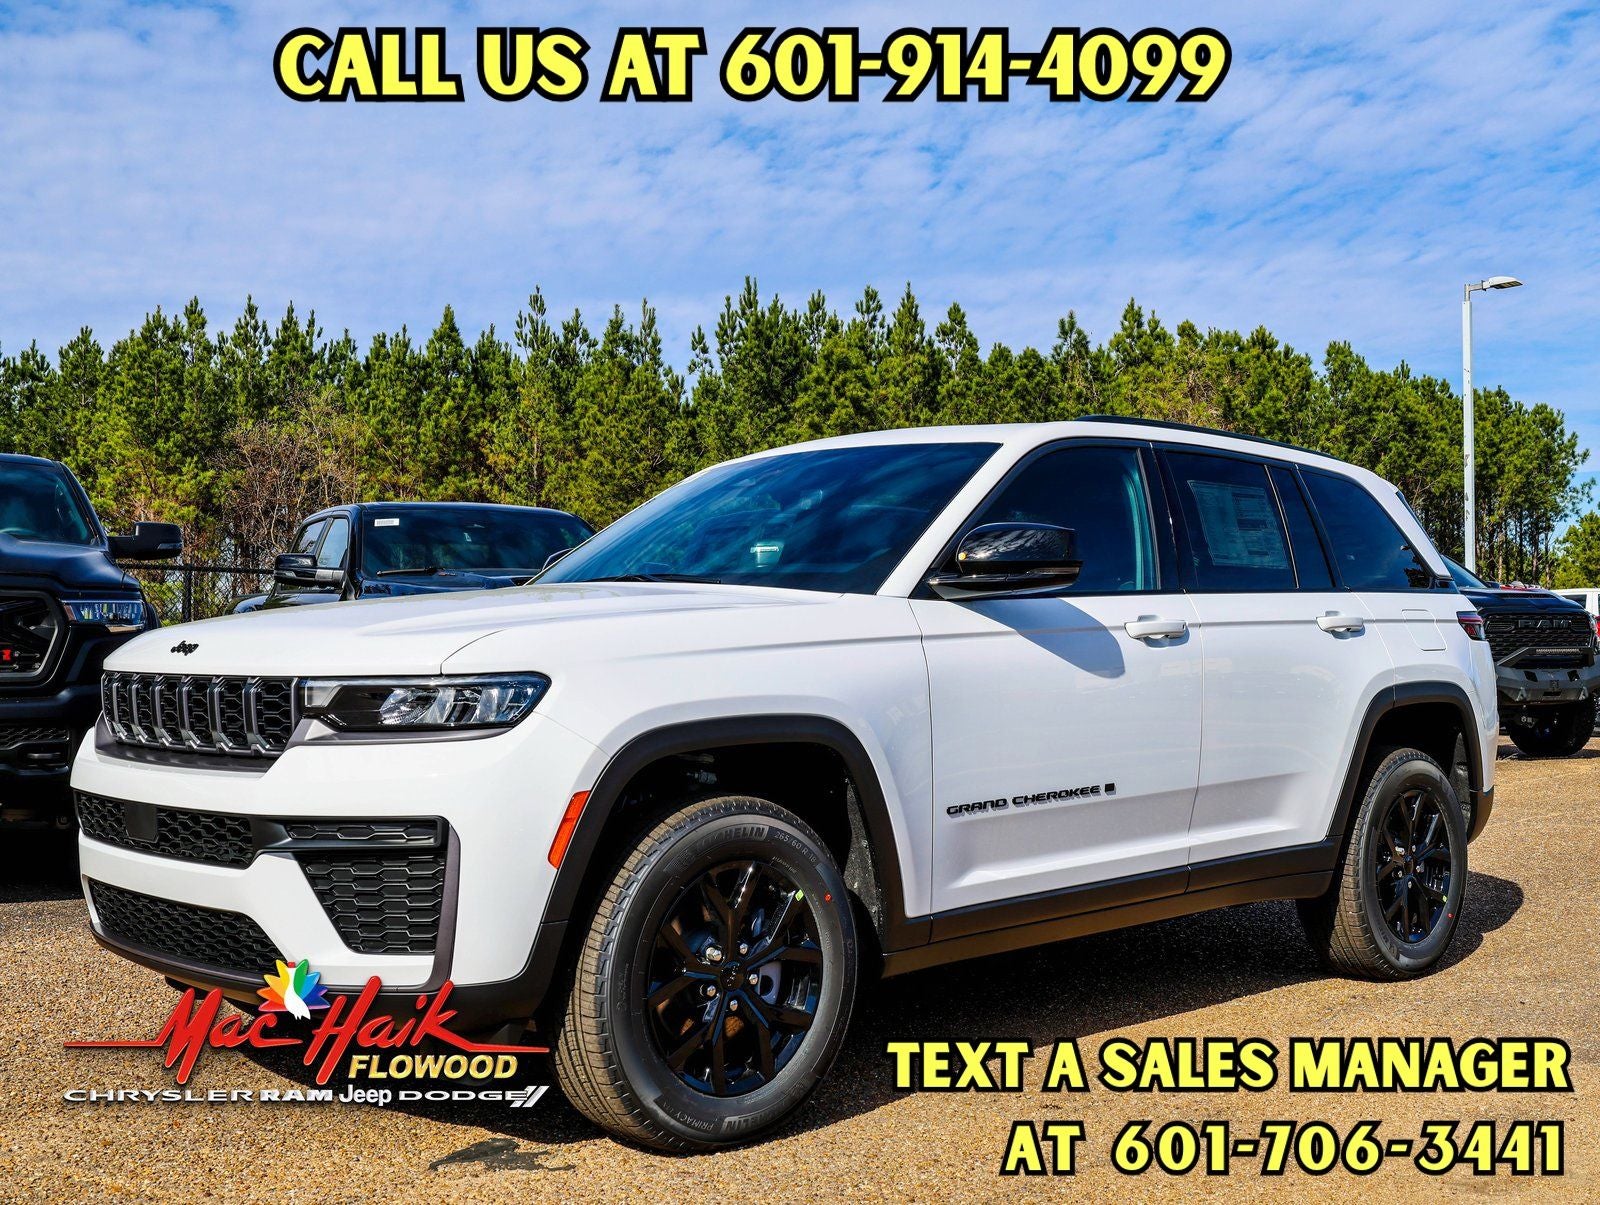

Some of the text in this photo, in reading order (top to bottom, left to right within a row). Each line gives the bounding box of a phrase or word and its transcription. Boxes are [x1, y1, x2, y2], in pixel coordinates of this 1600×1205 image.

[1518, 619, 1570, 629] RAM
[170, 640, 199, 656] Jeep
[946, 785, 1101, 815] GRAND CHEROKEE
[675, 1110, 714, 1132] PRIMACY
